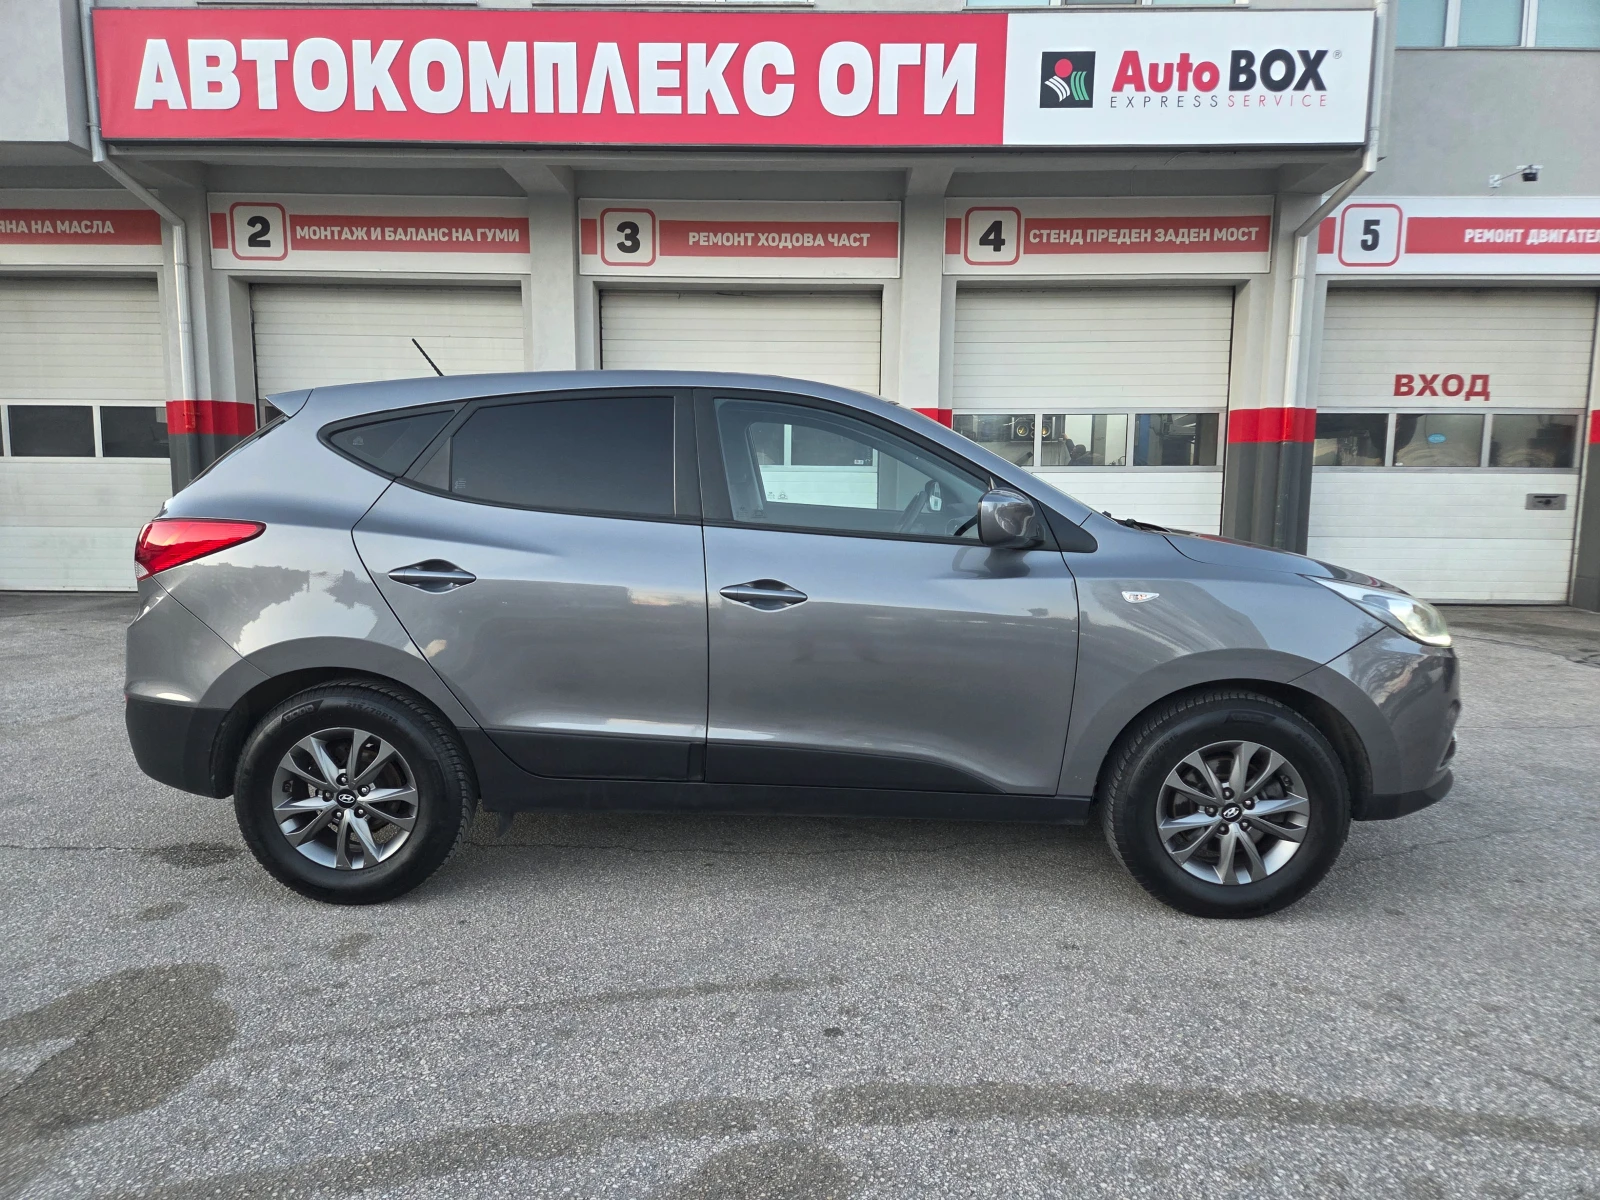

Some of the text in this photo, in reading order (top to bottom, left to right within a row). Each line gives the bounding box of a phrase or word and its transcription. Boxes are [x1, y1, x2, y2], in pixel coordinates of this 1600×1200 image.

[134, 38, 978, 117] АВТОКОМПЛЕКС ОГИ
[31, 220, 54, 234] НА
[56, 220, 115, 234] МАСЛА
[247, 215, 271, 248] 2
[296, 225, 520, 243] МОНТАЖ И БАЛАНС НА ГУМИ
[616, 220, 641, 254] 3
[688, 232, 870, 249] РЕМОНТ ХОДОВА ЧАСТ
[978, 220, 1006, 252] 4
[1029, 227, 1259, 245] СТЕНД ПРЕДЕН ЗАДЕН МОСТ
[1360, 219, 1381, 252] 5
[1463, 228, 1525, 243] РЕМОНТ
[1393, 374, 1491, 402] ВХОД
